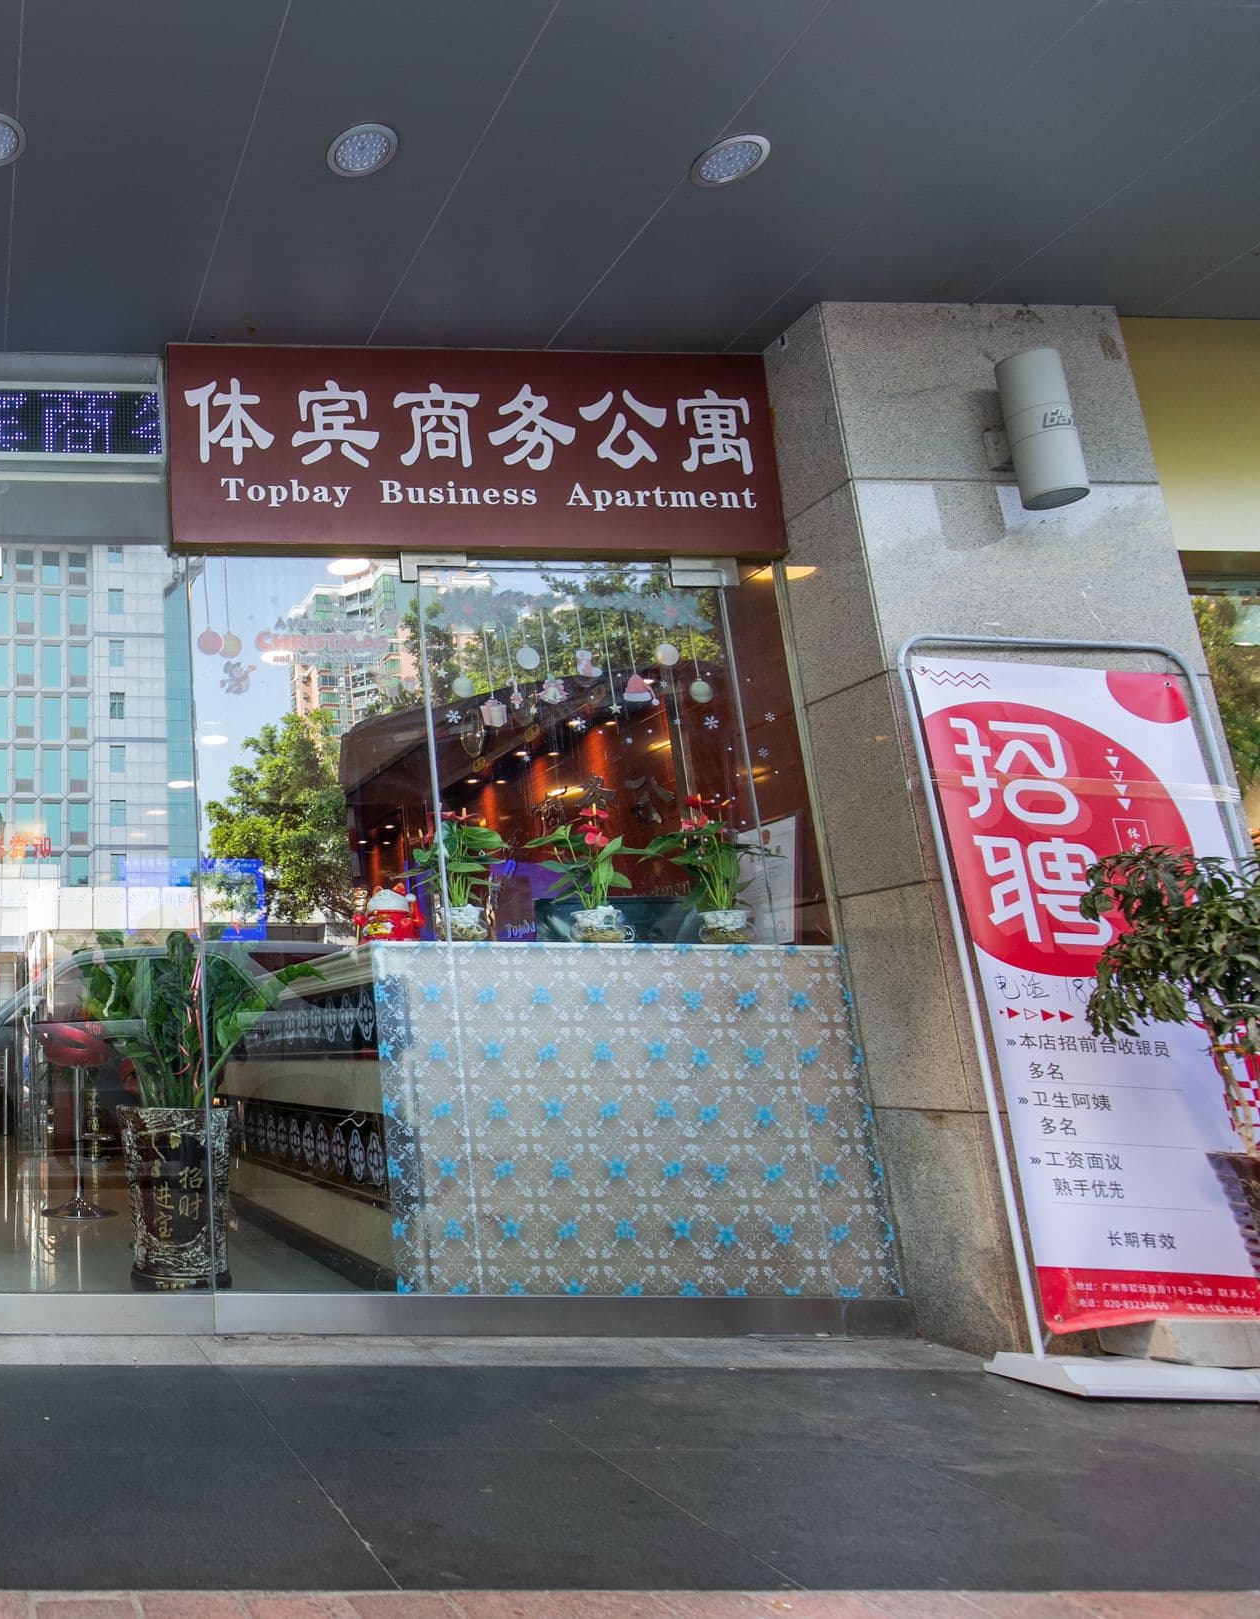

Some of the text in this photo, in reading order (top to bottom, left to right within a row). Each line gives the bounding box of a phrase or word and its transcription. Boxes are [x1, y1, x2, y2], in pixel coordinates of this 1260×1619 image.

[185, 377, 754, 475] 体宾商务公寓
[221, 477, 758, 512] Topbay Business Apartment
[949, 717, 1113, 947] 招聘
[1018, 1033, 1170, 1058] 本店招前台收银员
[1028, 1061, 1064, 1081] 多名
[1032, 1091, 1112, 1112] 卫生阿姨
[1040, 1117, 1077, 1137] 多名
[1045, 1151, 1123, 1172] 工资面议
[1053, 1178, 1124, 1199] 熟手优先
[1107, 1229, 1177, 1250] 长期有效
